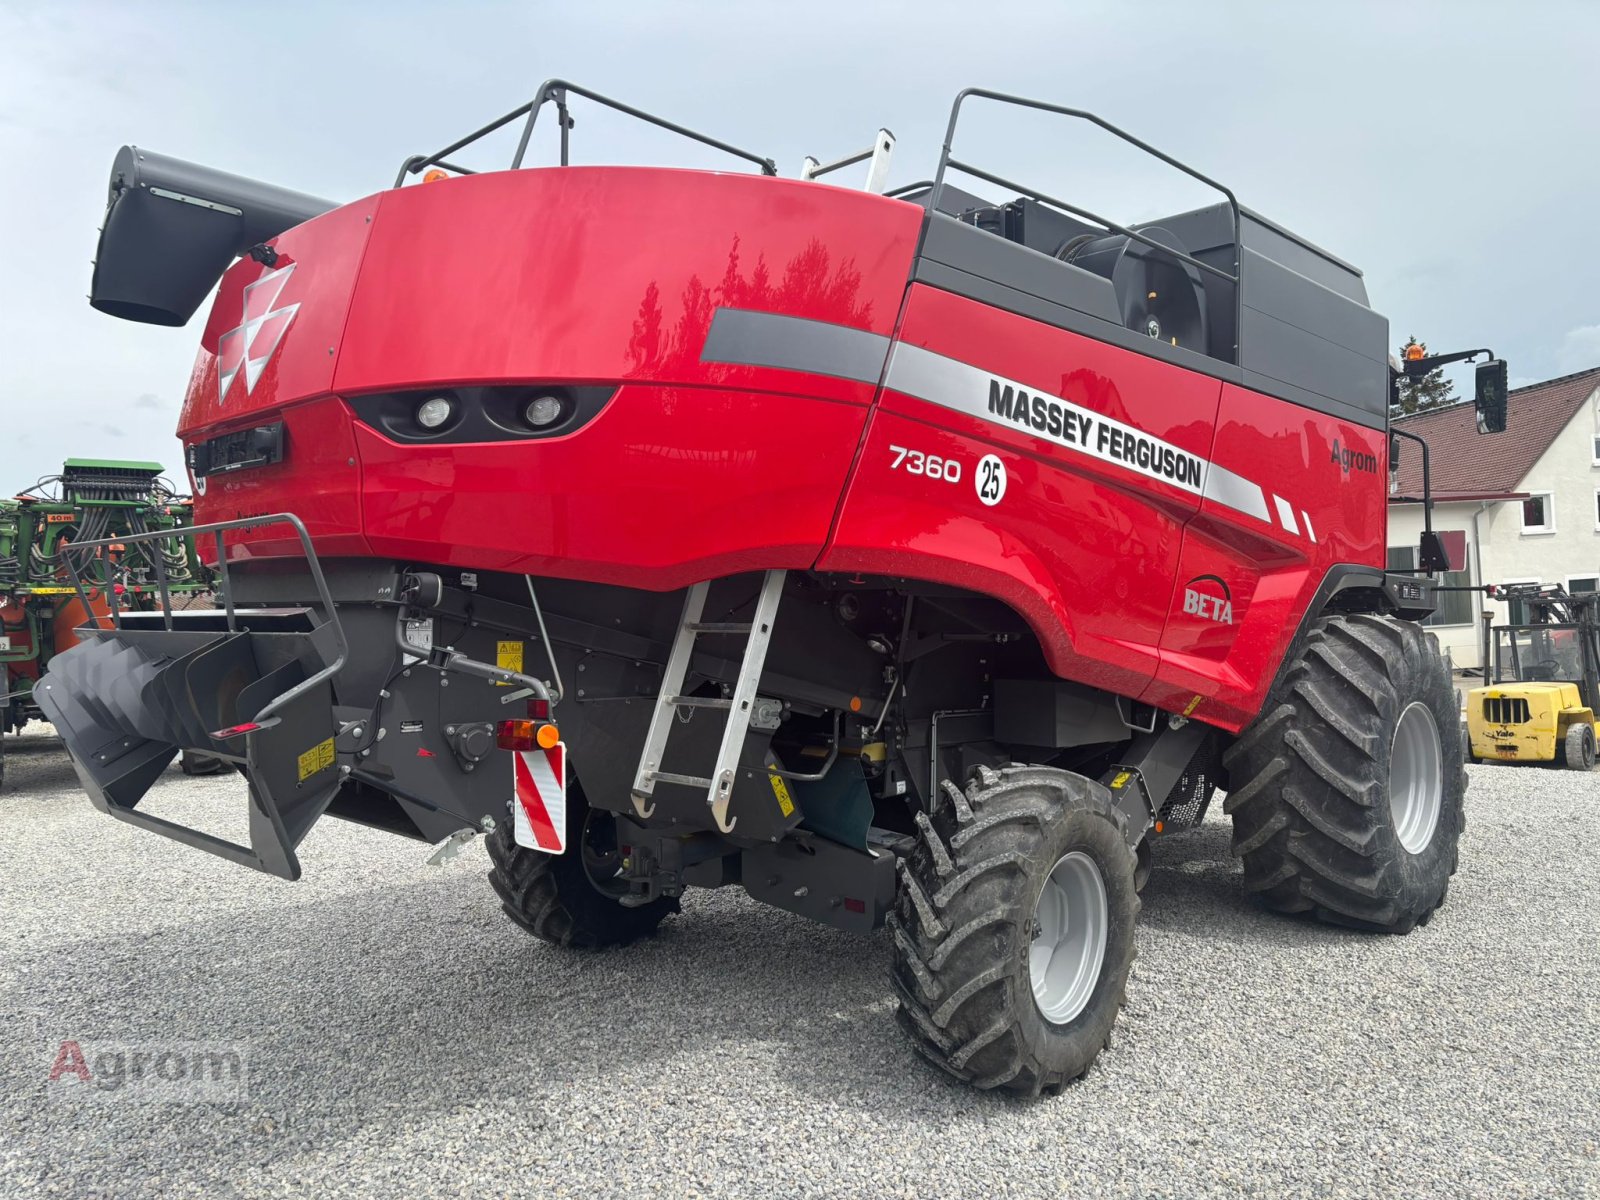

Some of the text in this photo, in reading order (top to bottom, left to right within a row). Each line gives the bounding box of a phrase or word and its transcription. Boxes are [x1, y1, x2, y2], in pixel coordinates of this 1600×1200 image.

[988, 379, 1201, 489] MASSEY FERGUSON
[889, 444, 962, 483] 7360
[1331, 439, 1377, 474] Agrom
[980, 460, 1001, 500] 25
[1183, 588, 1233, 626] BETA
